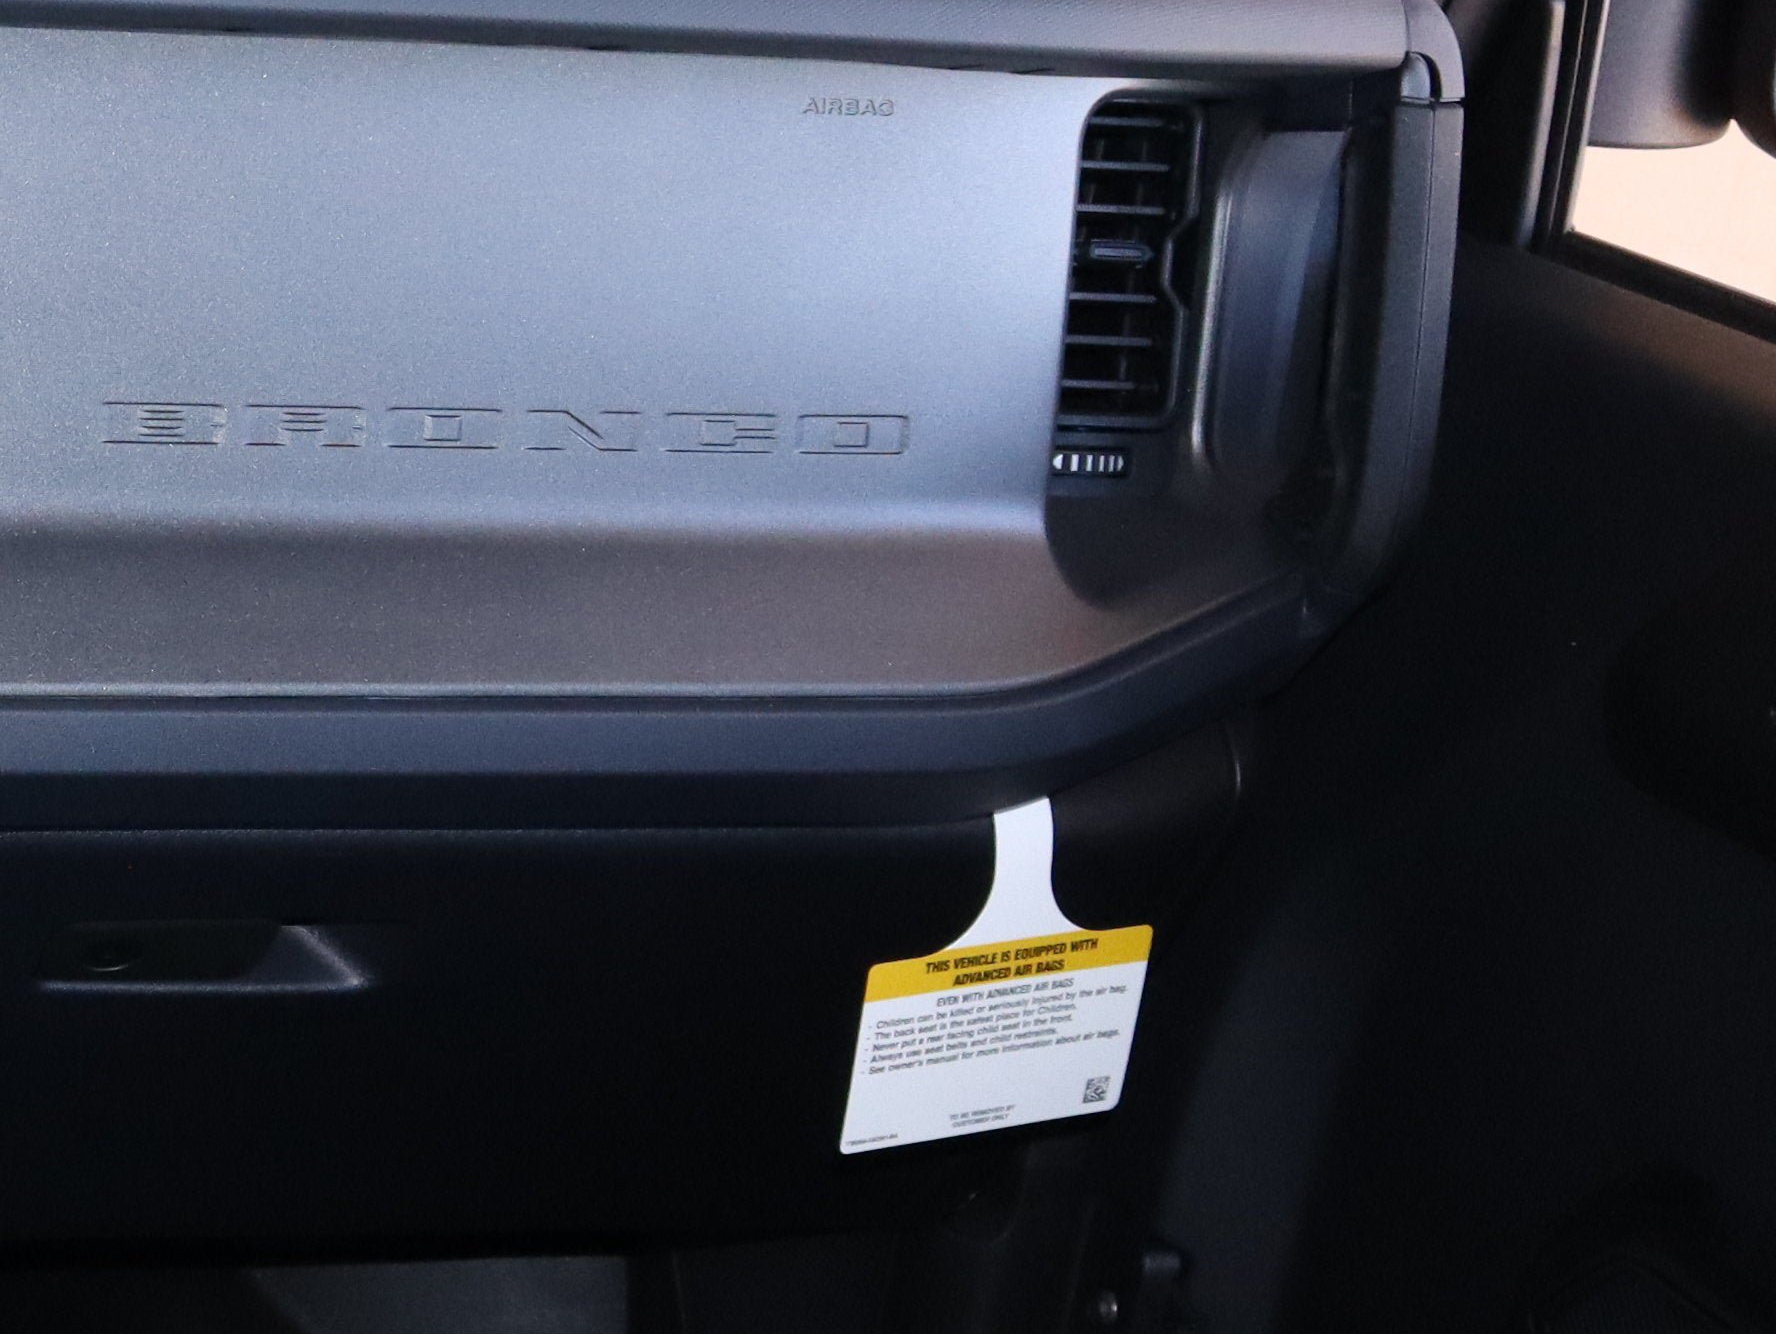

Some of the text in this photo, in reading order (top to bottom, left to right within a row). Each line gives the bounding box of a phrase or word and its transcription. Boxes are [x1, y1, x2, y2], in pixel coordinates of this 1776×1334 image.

[802, 98, 894, 116] AIRBAG
[103, 402, 908, 454] BRONCO
[926, 938, 1099, 974] THIS VEHICLE IS EQUIPPED WITH
[953, 959, 1065, 986] ADVANCED AIR BAGS
[937, 996, 959, 1007] EVEN
[962, 992, 985, 1003] WITH
[986, 984, 1032, 999] ADVANCED
[1051, 978, 1074, 990] BAGS
